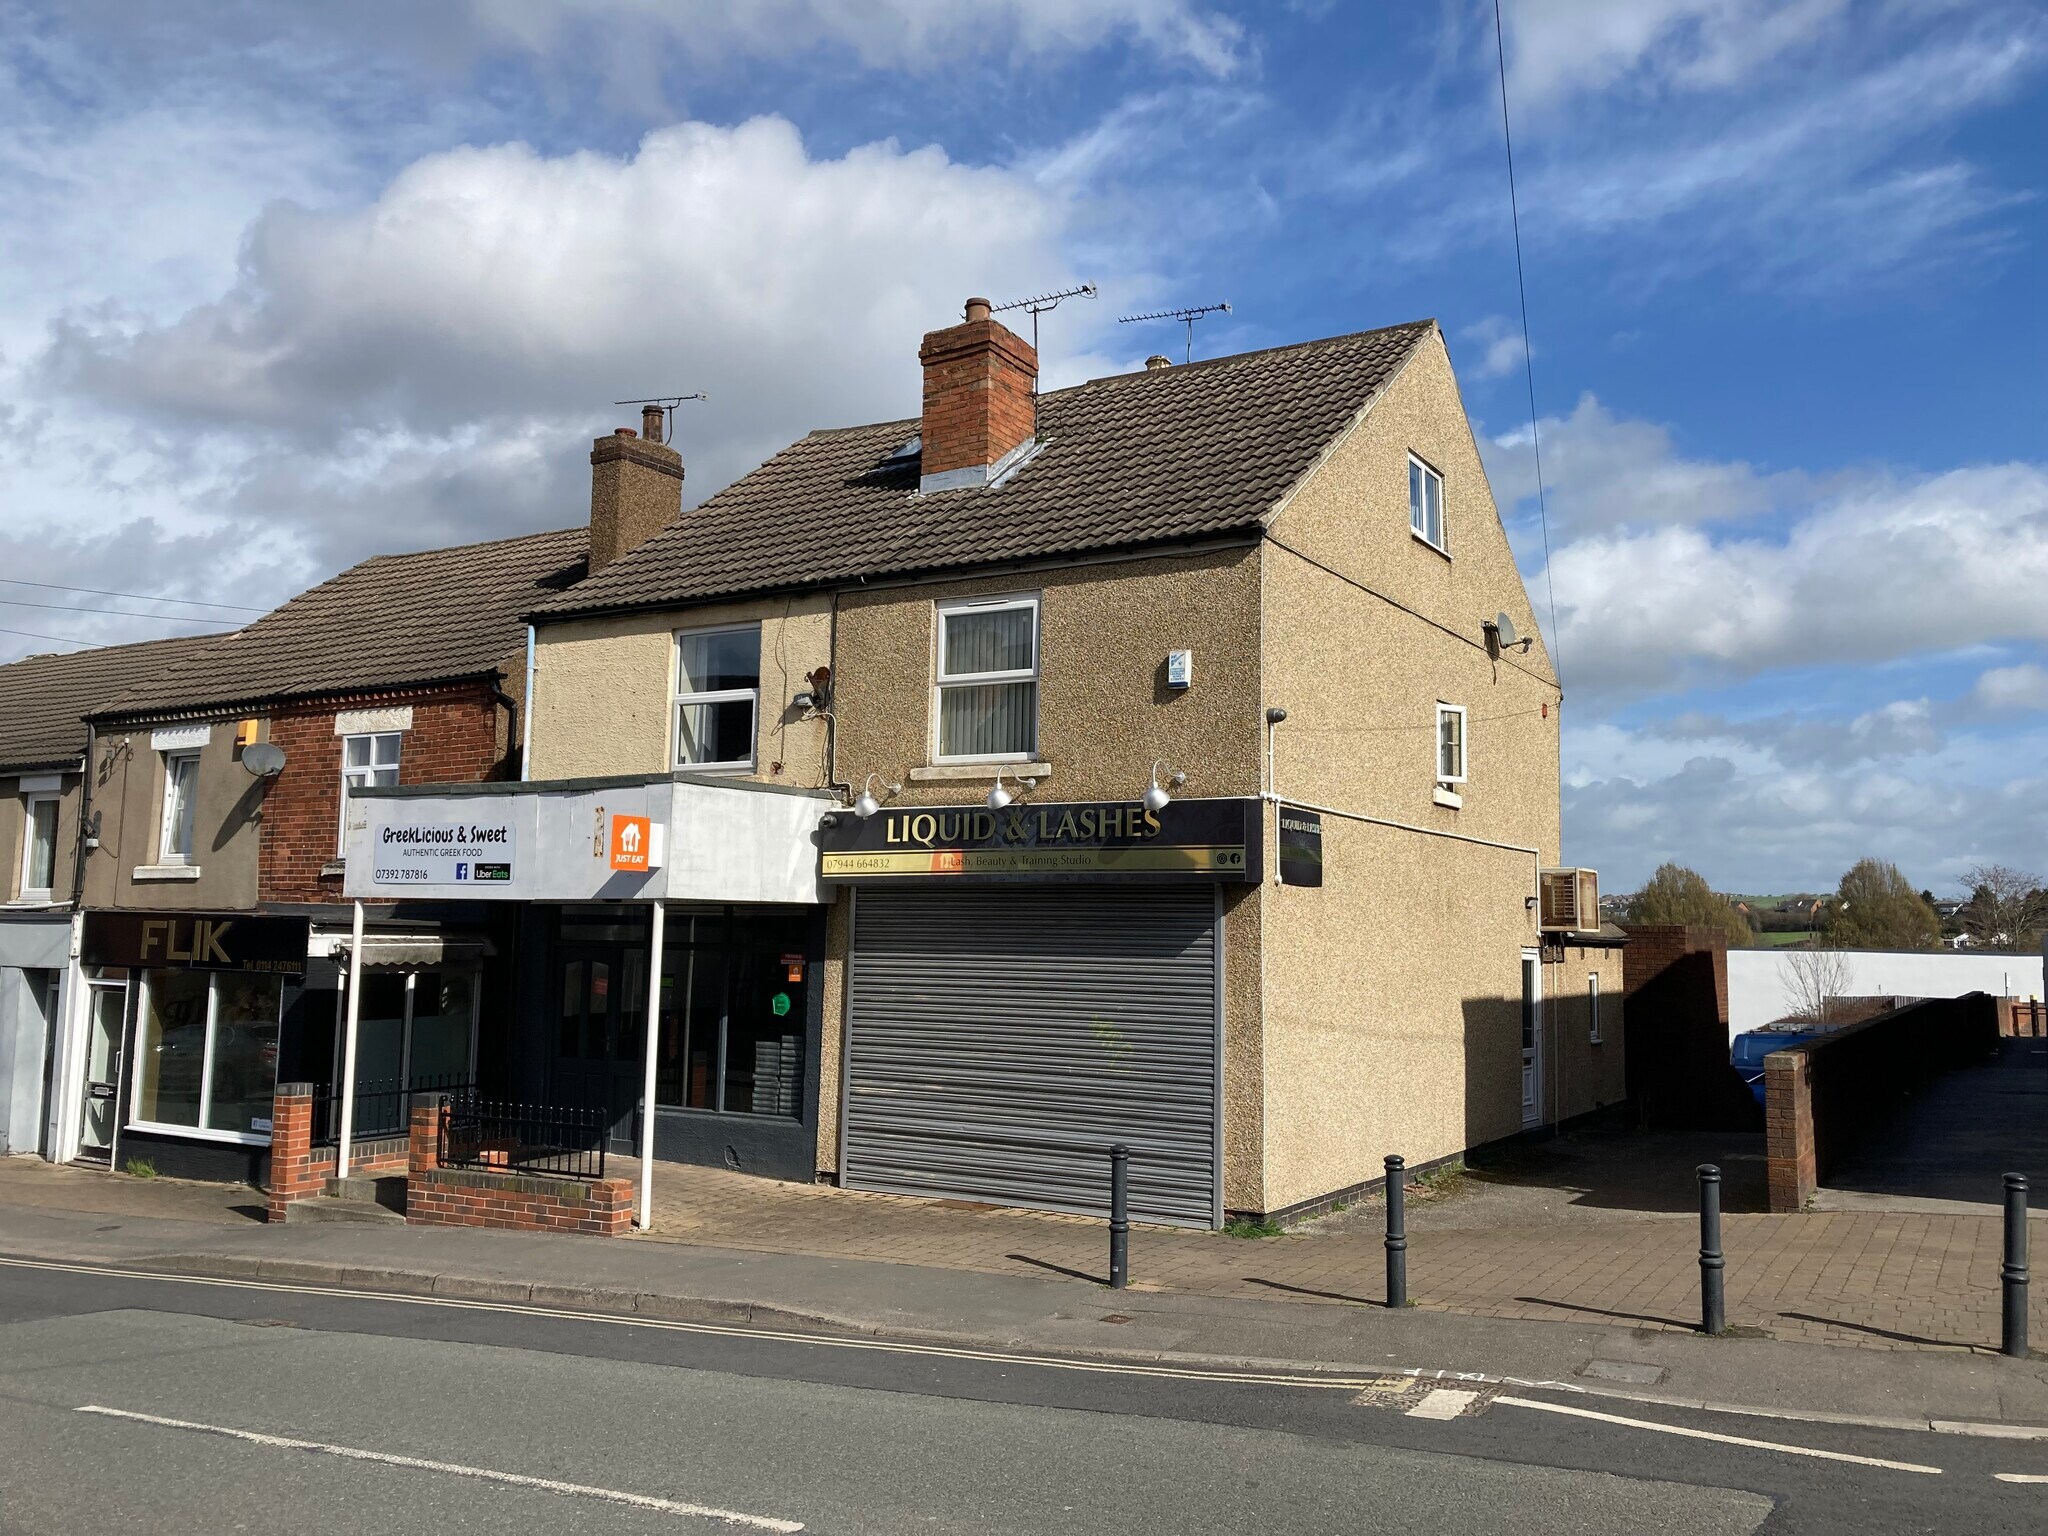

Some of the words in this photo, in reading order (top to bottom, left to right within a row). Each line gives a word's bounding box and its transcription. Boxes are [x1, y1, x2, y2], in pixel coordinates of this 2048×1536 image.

[887, 812, 996, 849] LIQUID
[1005, 811, 1028, 841] &
[1039, 807, 1162, 840] LASHES
[383, 827, 454, 843] GreekLicious
[457, 825, 467, 843] &
[470, 825, 507, 843] Sweet
[402, 849, 439, 857] AUTHENTIC
[440, 848, 461, 857] GREEK
[462, 848, 483, 857] FOOD
[615, 854, 632, 863] JUST
[631, 855, 645, 863] EAT
[826, 860, 854, 869] 07944
[856, 858, 890, 869] 664832
[950, 856, 973, 867] Lash,
[976, 856, 1005, 868] Beauty
[1009, 857, 1017, 865] &
[1021, 855, 1057, 867] Training
[1061, 855, 1091, 865] Studio
[375, 869, 399, 880] 07392
[400, 869, 428, 880] 787816
[476, 869, 492, 879] Uber
[492, 869, 509, 879] Eats
[140, 919, 233, 963] FLIK
